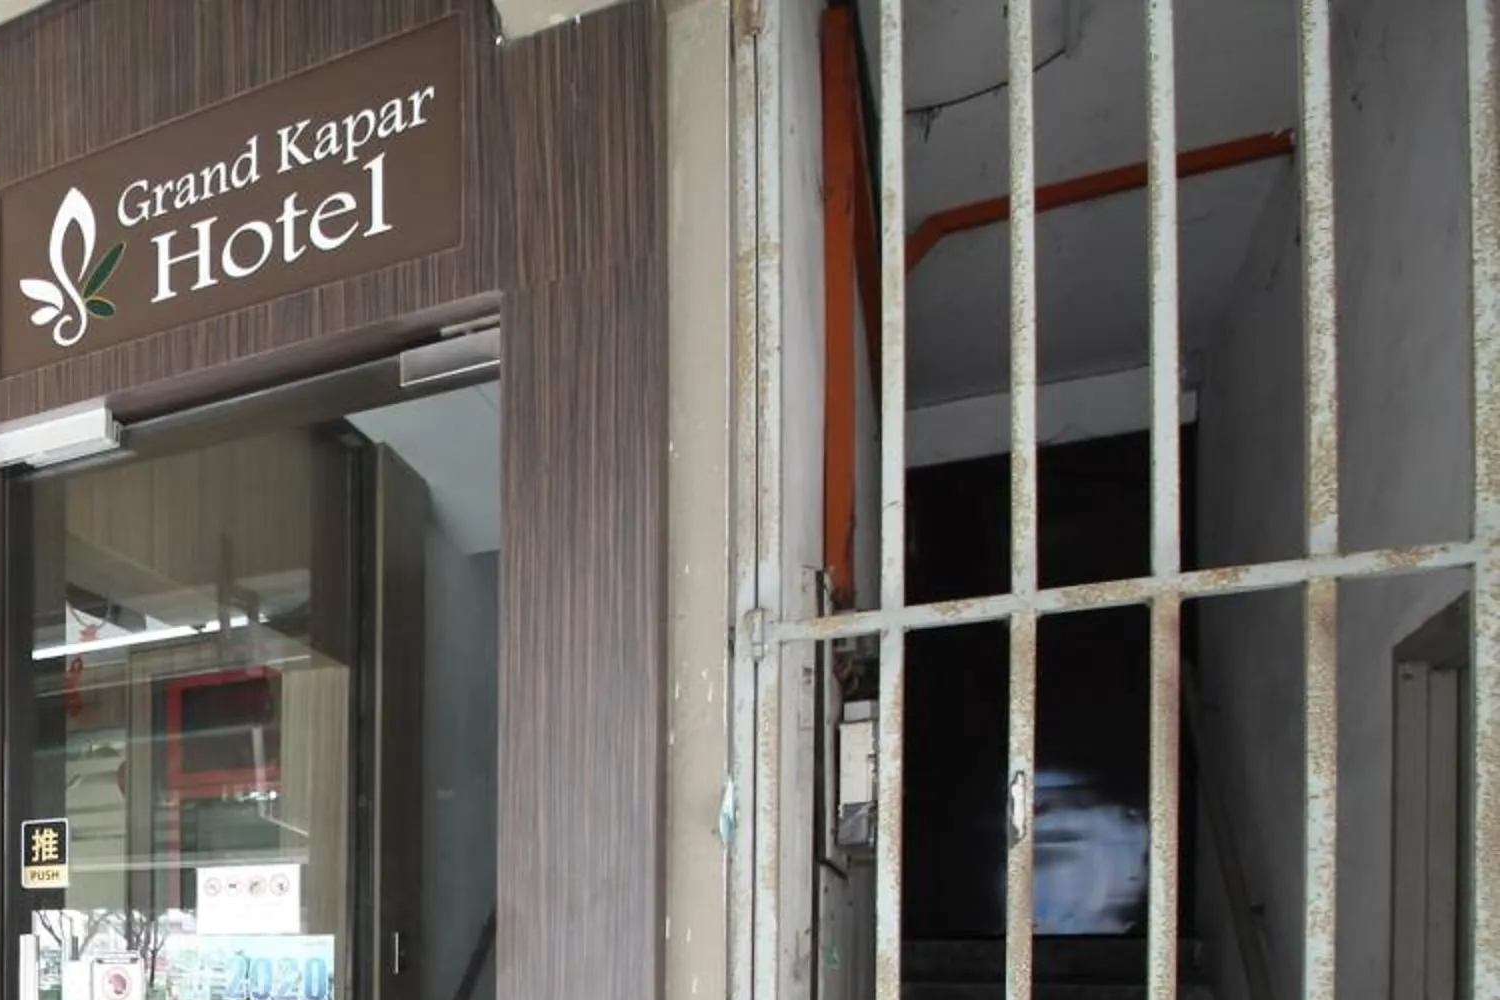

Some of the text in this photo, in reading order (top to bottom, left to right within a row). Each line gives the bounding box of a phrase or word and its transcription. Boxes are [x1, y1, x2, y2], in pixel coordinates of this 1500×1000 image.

[117, 85, 435, 227] Grand Kapar
[150, 151, 393, 303] Hotel
[31, 828, 59, 862] 推
[30, 869, 59, 881] PUSH
[226, 954, 328, 1000] 2020
